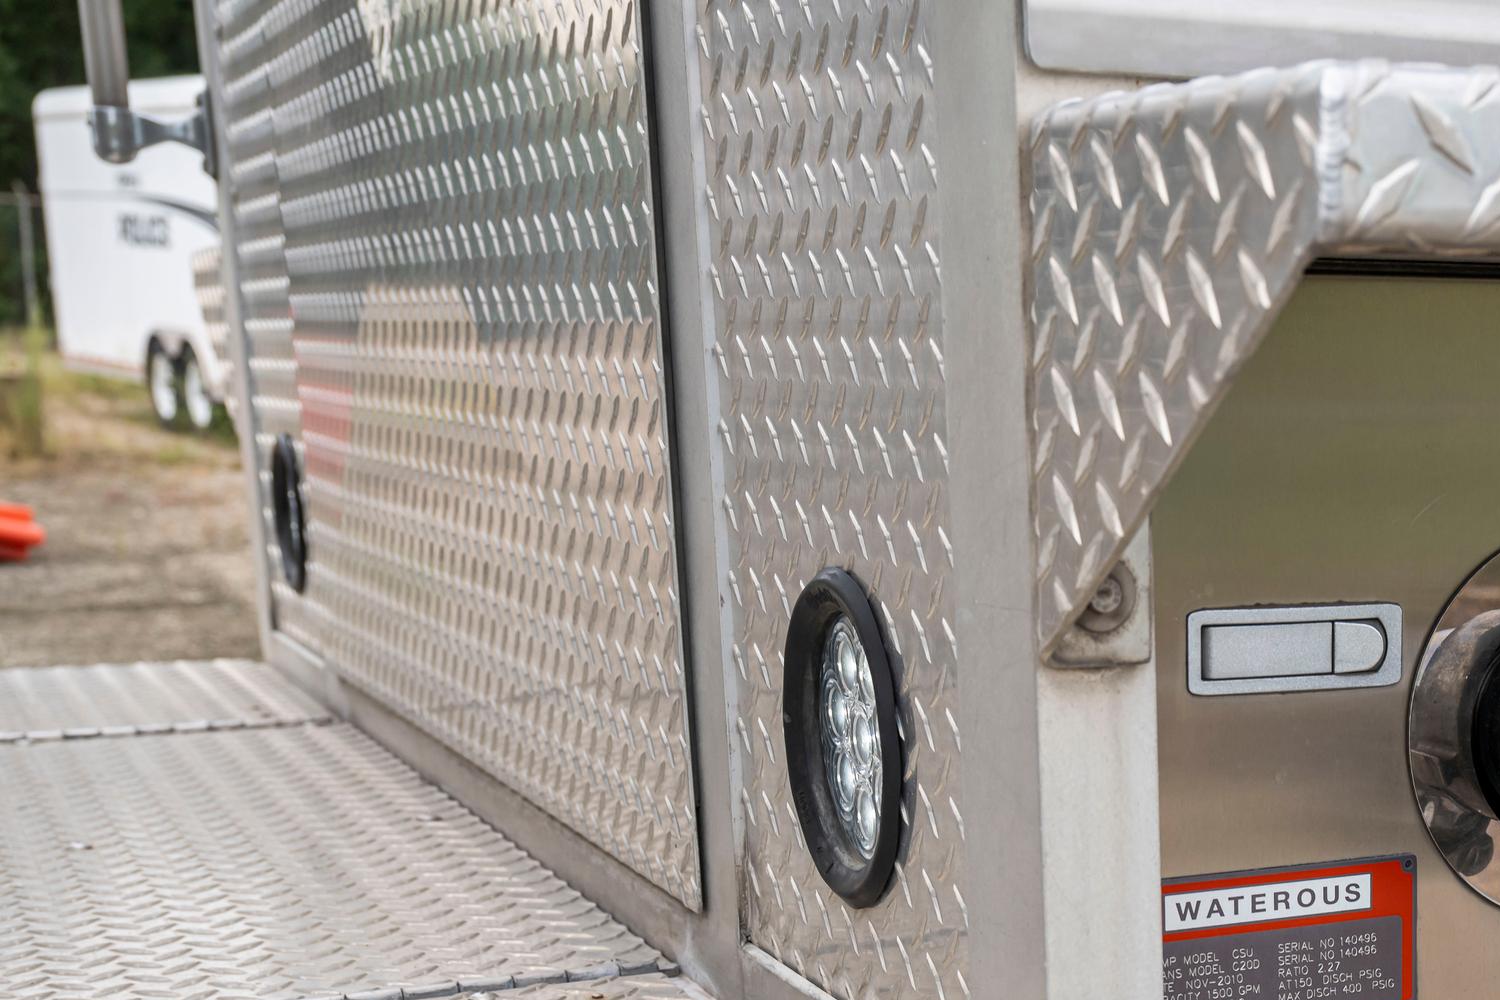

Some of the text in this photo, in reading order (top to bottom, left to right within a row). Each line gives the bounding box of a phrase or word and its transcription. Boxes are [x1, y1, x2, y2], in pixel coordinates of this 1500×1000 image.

[1175, 883, 1362, 922] WATEROUS
[1278, 932, 1377, 954] SERIAL NO 140496
[1183, 952, 1219, 965] MODEL
[1232, 948, 1254, 959] CSU
[1278, 945, 1377, 966] SERIAL NO 140496
[1189, 963, 1225, 977] MODEL
[1278, 961, 1341, 978] RATIO 2.27
[1323, 972, 1353, 985] DISCH
[1359, 968, 1382, 979] PSIG
[1186, 973, 1244, 990] NOV-2010
[1306, 987, 1337, 999] DISCH
[1342, 983, 1362, 994] 400
[1372, 978, 1395, 990] PSIG
[1208, 987, 1233, 999] 1500
[1238, 984, 1261, 996] GPM
